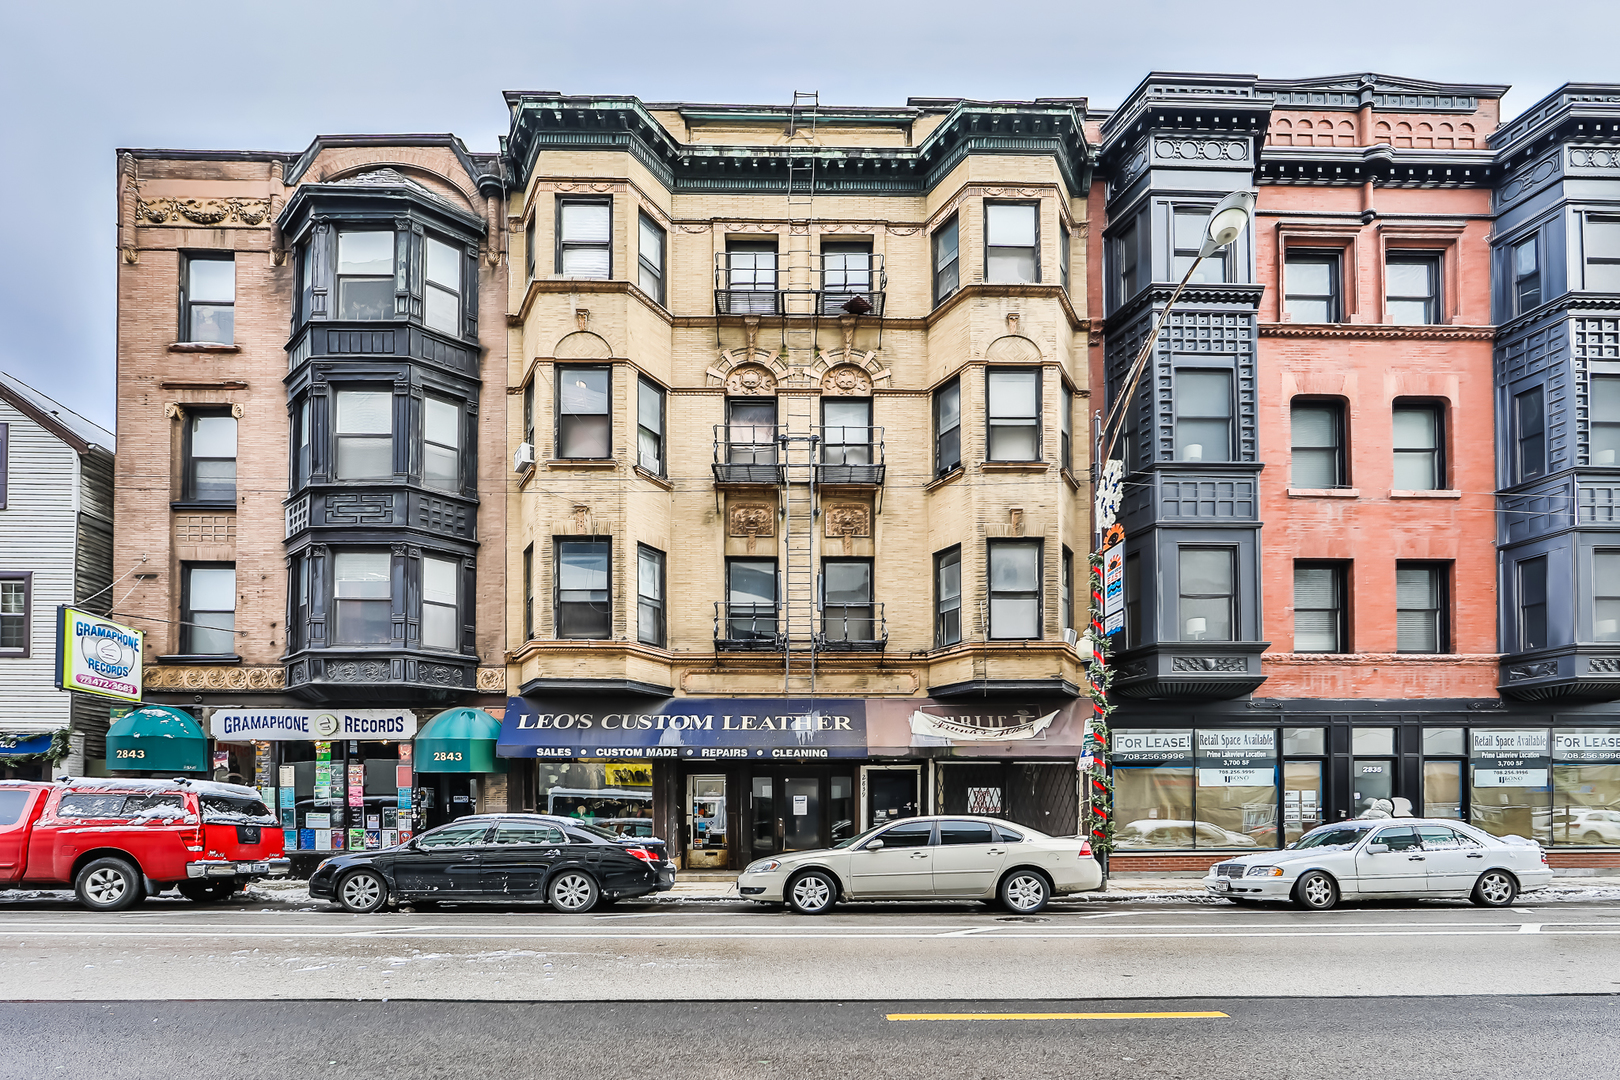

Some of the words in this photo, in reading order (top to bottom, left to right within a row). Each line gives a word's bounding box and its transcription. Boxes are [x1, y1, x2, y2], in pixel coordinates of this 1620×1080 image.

[76, 621, 140, 653] GRAMAPHONE
[88, 657, 129, 677] RECORDS
[224, 715, 309, 734] GRAMAPHONE
[344, 715, 404, 733] RECORDS
[516, 713, 594, 730] LEO'S
[601, 713, 714, 731] CUSTOM
[721, 714, 853, 731] LEATHER
[1116, 736, 1142, 748] FOR
[1145, 735, 1191, 749] LEASE!
[1199, 734, 1219, 746] Retail
[1221, 734, 1241, 749] Space
[1244, 733, 1273, 746] Available
[1474, 735, 1494, 747] Retail
[1496, 735, 1515, 749] Space
[1516, 734, 1547, 747] Available
[1556, 736, 1580, 748] FOR
[116, 749, 146, 759] 2843
[433, 752, 463, 761] 2843
[536, 748, 572, 757] SALES
[595, 748, 643, 757] CUSTOM
[646, 748, 678, 757] MADE
[701, 748, 748, 757] REPAIRS
[771, 749, 828, 758] CLEANING
